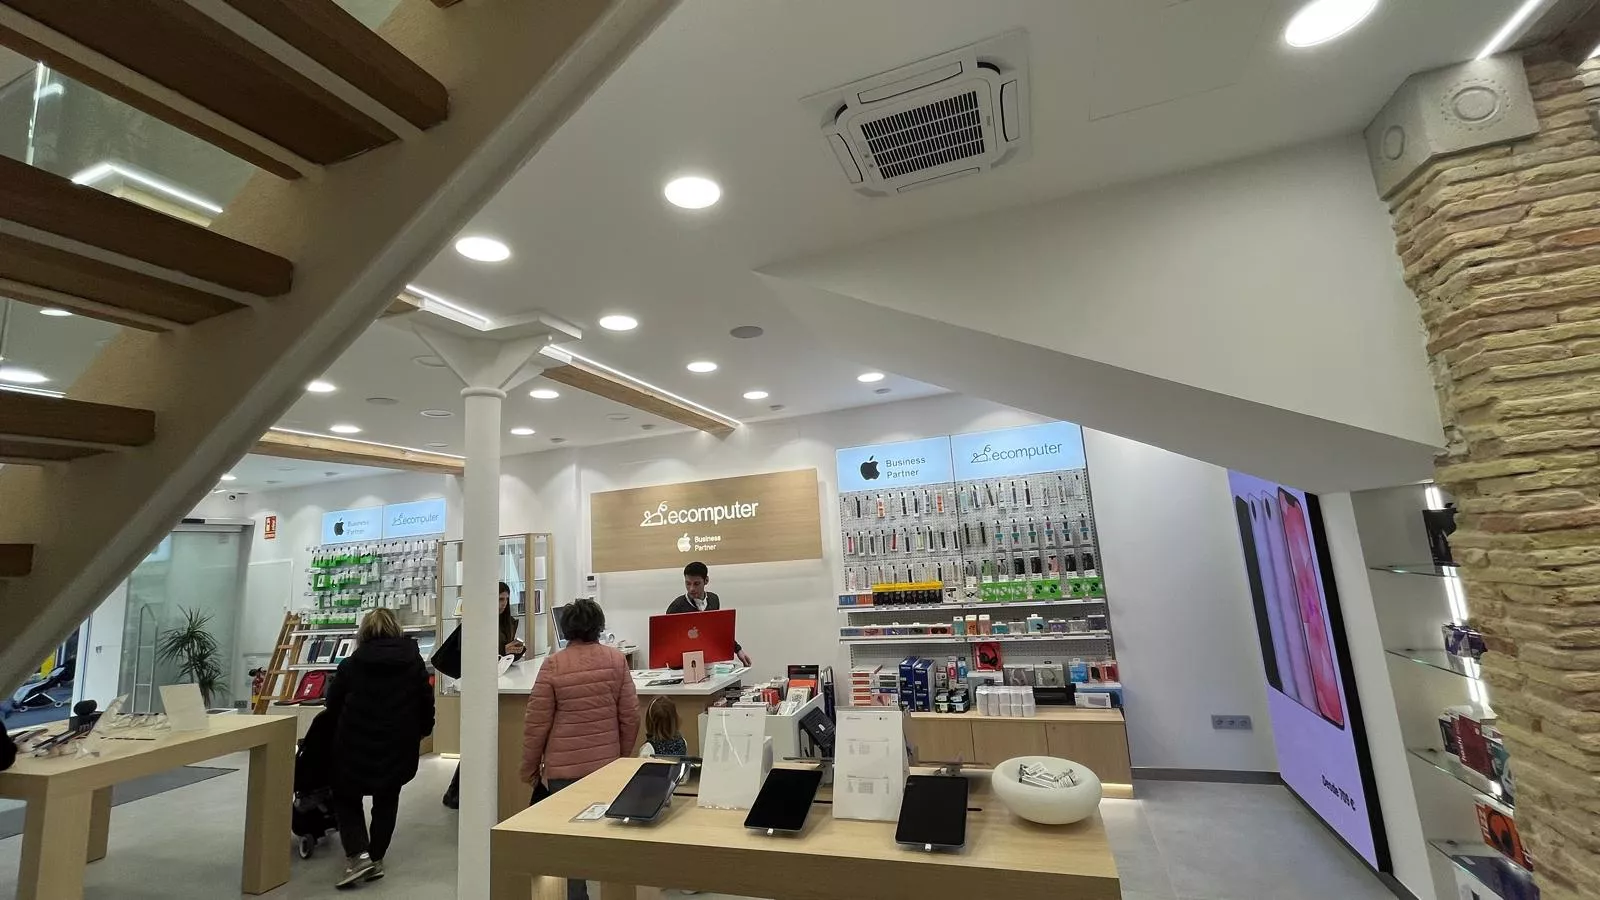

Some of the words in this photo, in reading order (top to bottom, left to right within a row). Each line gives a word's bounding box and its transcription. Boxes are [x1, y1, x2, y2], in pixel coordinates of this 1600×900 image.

[885, 457, 926, 468] Business
[886, 469, 919, 479] Partner
[694, 535, 721, 543] Business
[694, 544, 717, 552] Partner
